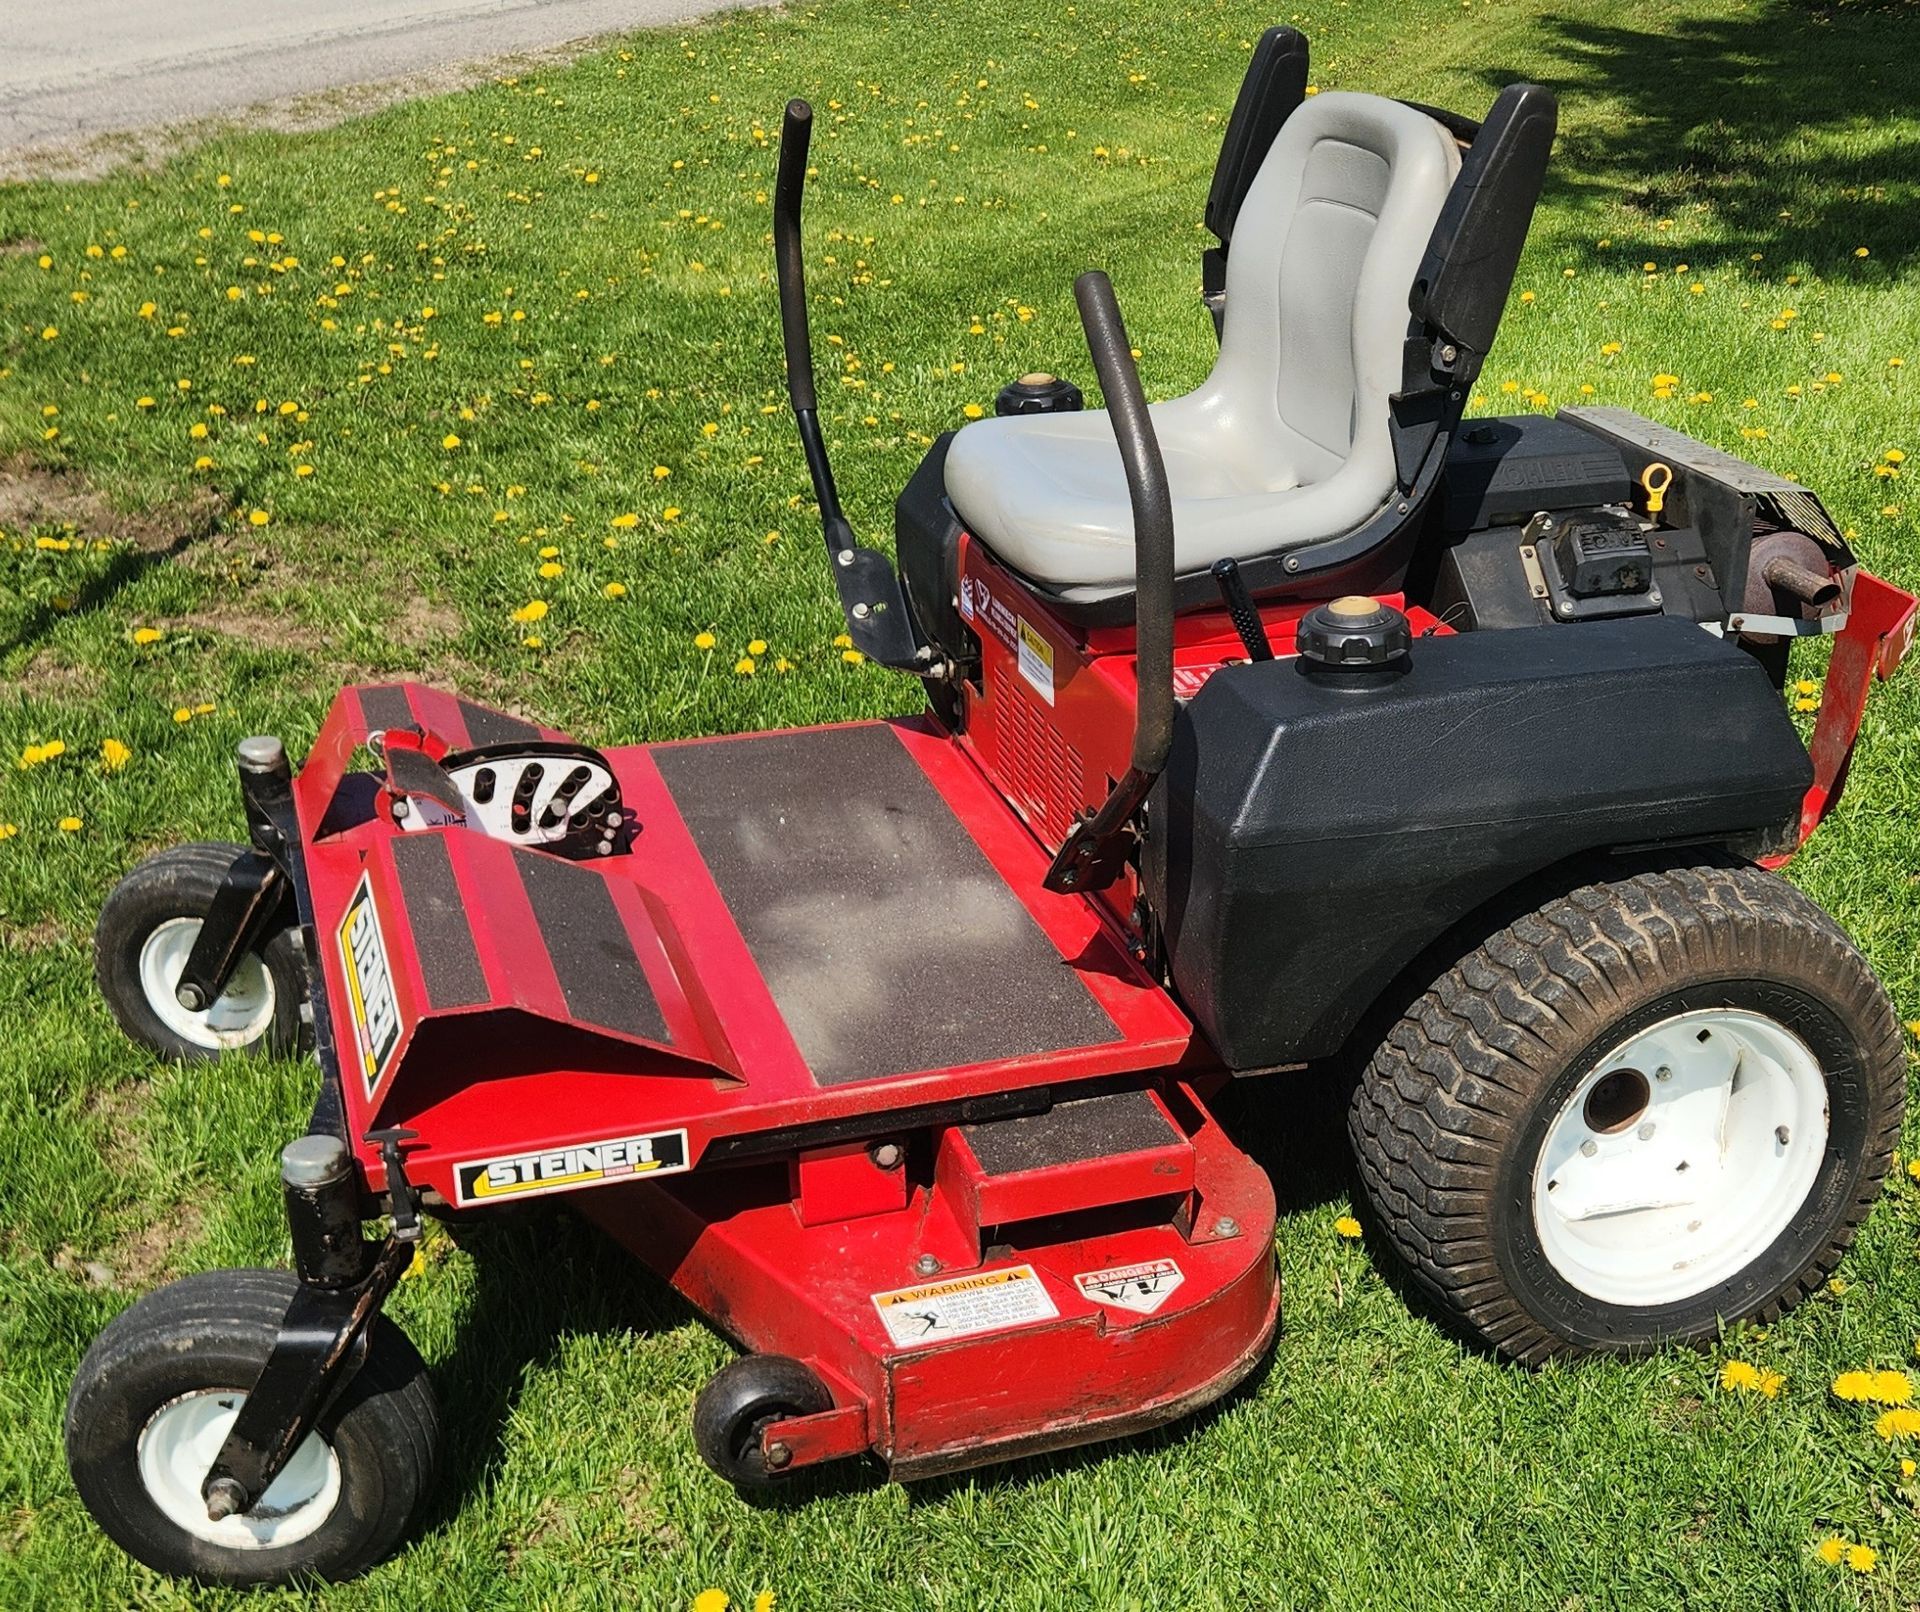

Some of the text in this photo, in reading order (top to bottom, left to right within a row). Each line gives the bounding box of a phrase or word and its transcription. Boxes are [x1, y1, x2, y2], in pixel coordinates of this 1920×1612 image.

[349, 896, 396, 1060] STEINER
[487, 1138, 654, 1188] STEINER
[1098, 1264, 1154, 1283] DANGER
[910, 1274, 1000, 1300] WARNING
[938, 1279, 1033, 1302] THROWN OBJECTS
